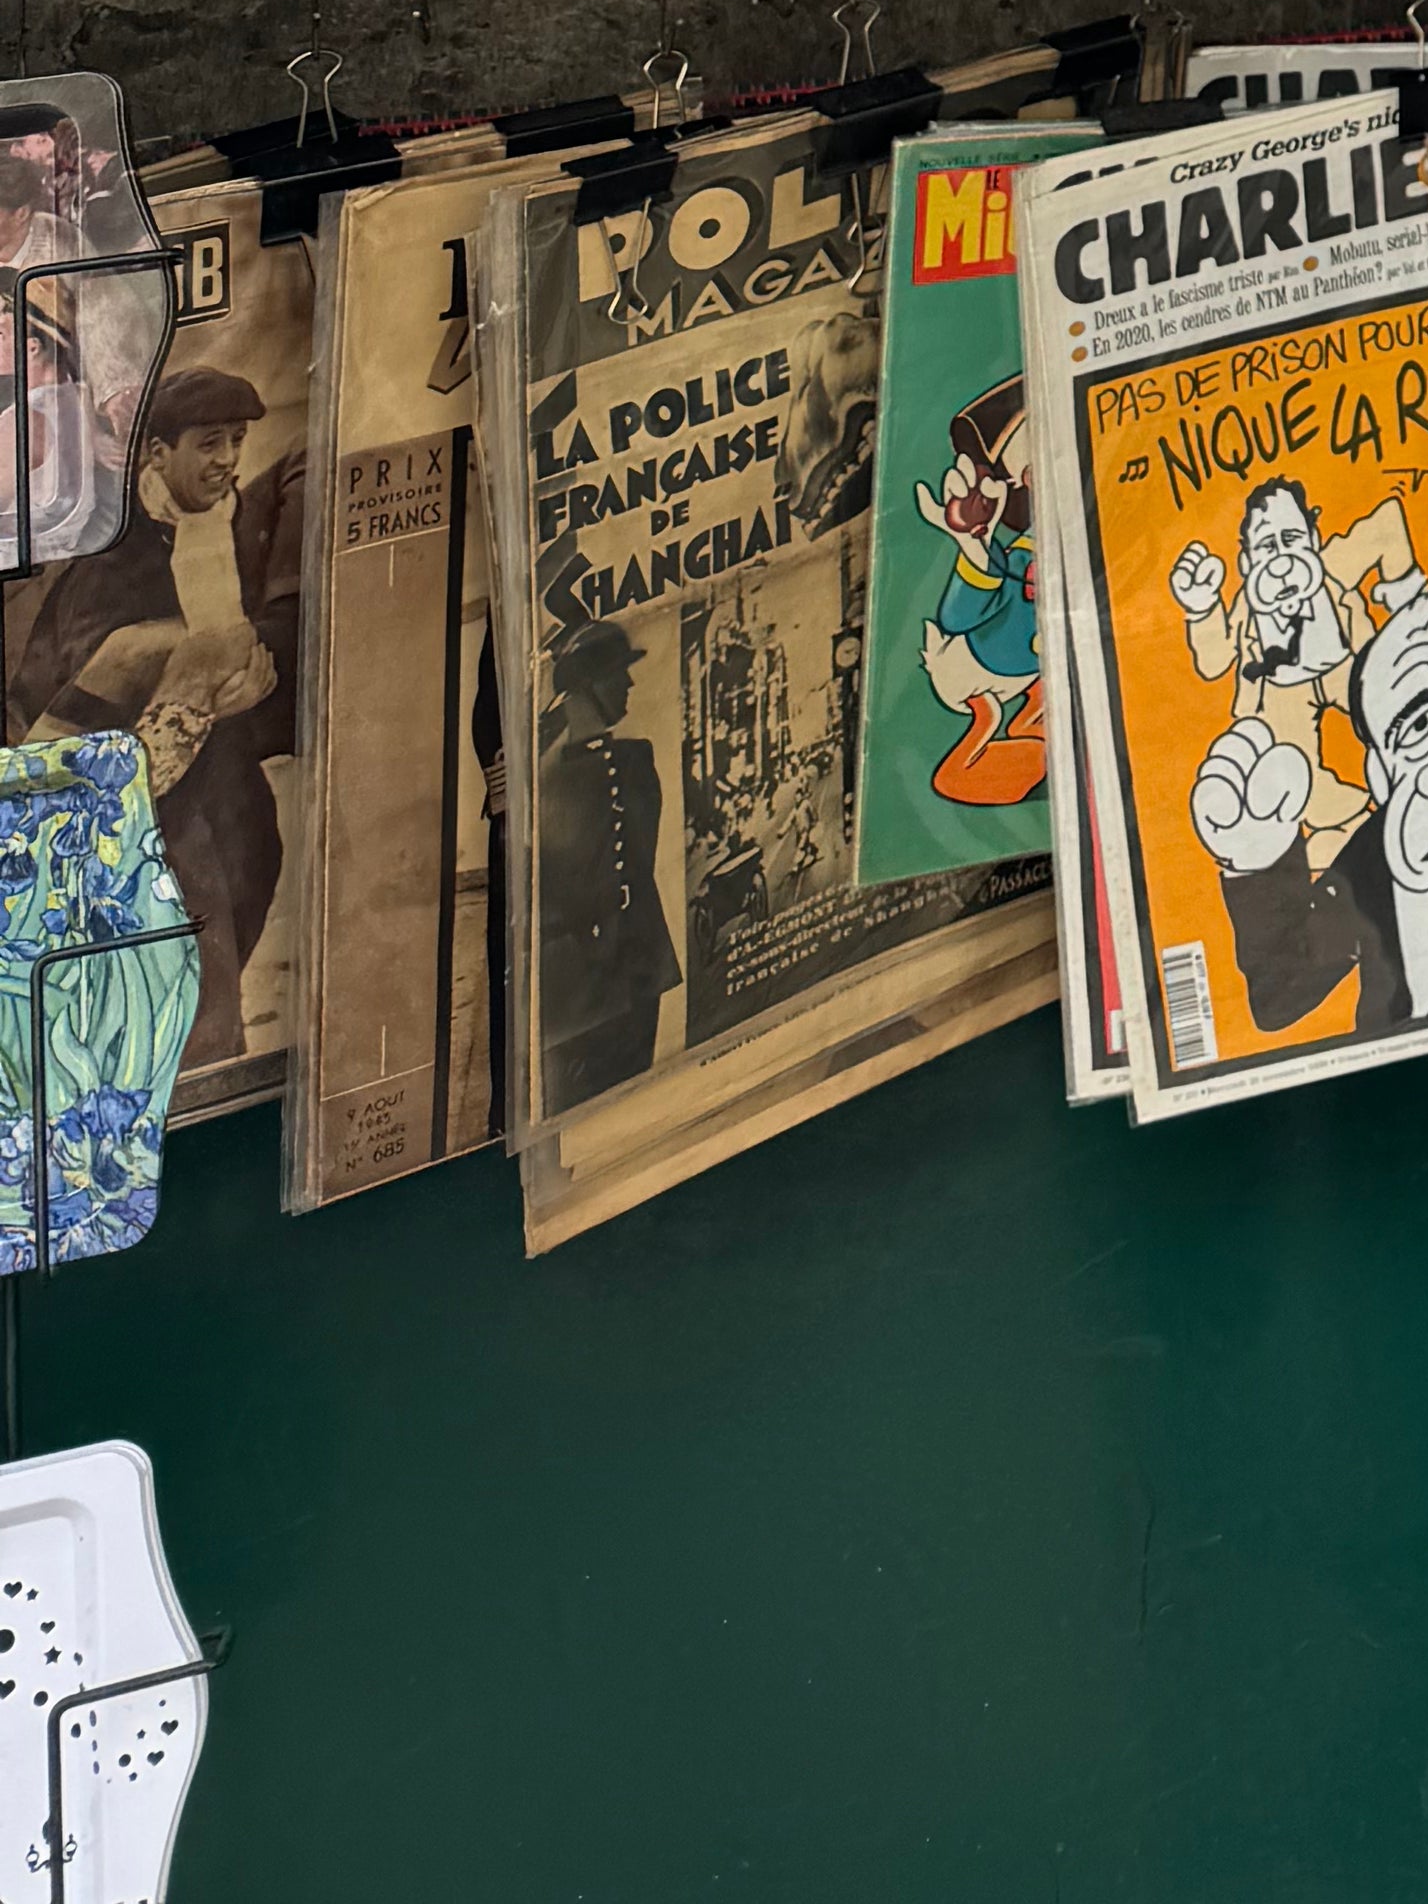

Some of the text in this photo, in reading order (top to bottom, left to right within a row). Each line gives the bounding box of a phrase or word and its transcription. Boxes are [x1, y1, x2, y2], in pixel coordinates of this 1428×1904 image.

[919, 155, 984, 168] NOUVELLE
[1169, 117, 1364, 185] Crazy George's
[1092, 334, 1114, 359] En
[1115, 324, 1156, 352] 2020,
[1158, 313, 1179, 339] les
[1181, 297, 1232, 333] cendres
[1234, 294, 1254, 320] de
[1255, 285, 1289, 311] NTM
[1292, 282, 1312, 301] au
[1312, 259, 1385, 299] Panthéon?
[1093, 304, 1136, 331] Dreux
[1139, 303, 1150, 318] a
[1152, 295, 1166, 314] le
[1167, 277, 1225, 310] fascisme
[1227, 268, 1264, 295] triste
[1330, 234, 1384, 266] Mobutu,
[536, 348, 792, 480] LA POLICE
[1095, 379, 1167, 434] PAS
[1174, 357, 1224, 409] DE
[1231, 328, 1347, 393] PRiSON
[350, 447, 443, 495] PRIX
[1157, 376, 1322, 512] NiQUE
[1330, 382, 1383, 465] LA
[348, 482, 442, 513] PROVISOIRE
[538, 415, 780, 544] FRANÇAISE
[347, 500, 442, 544] 5 FRANCS
[649, 499, 691, 537] DE
[543, 482, 793, 644] SHANGHAÏ
[364, 1088, 405, 1116] AOUT
[372, 1136, 406, 1164] 685
